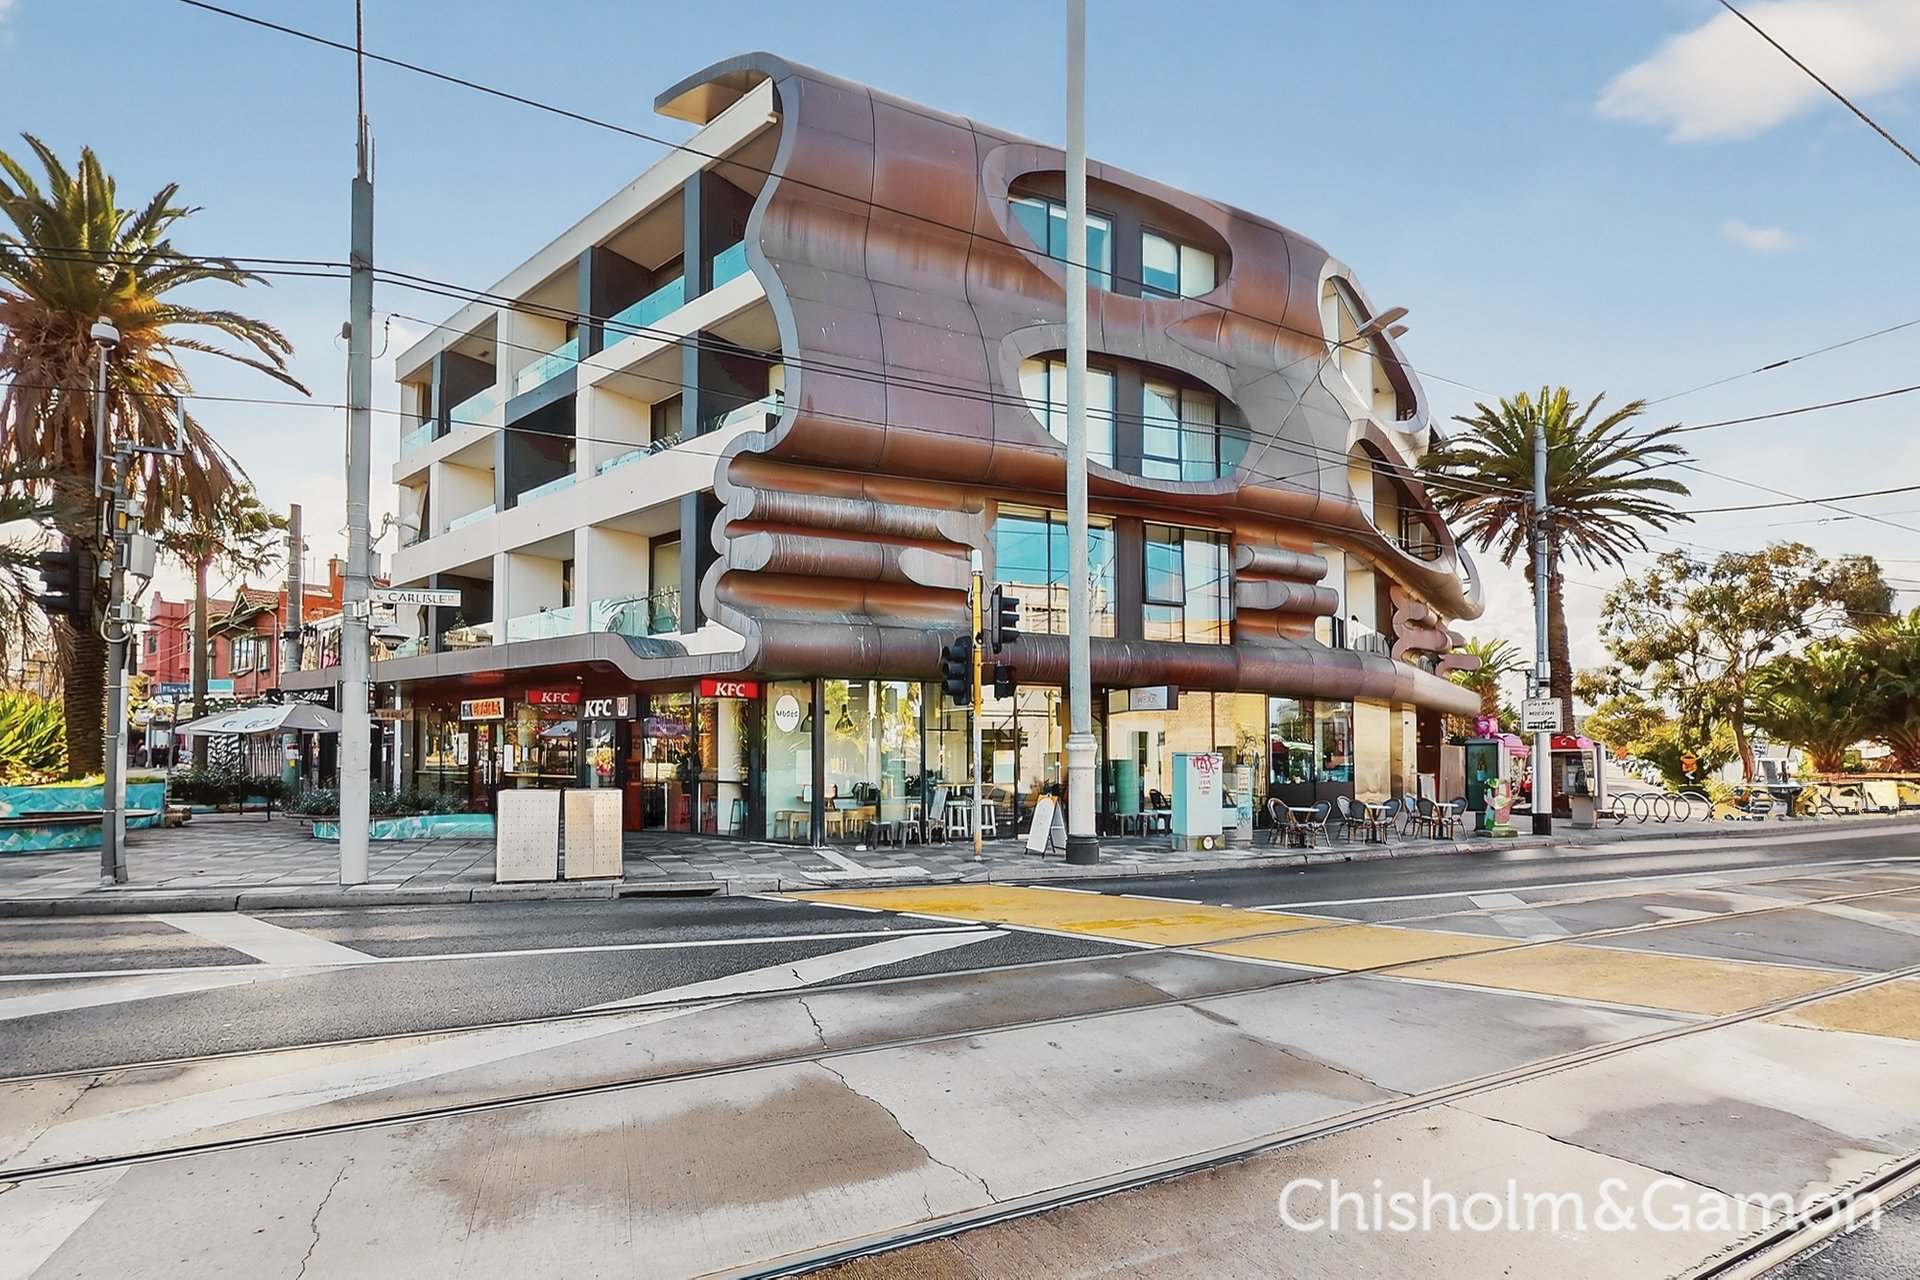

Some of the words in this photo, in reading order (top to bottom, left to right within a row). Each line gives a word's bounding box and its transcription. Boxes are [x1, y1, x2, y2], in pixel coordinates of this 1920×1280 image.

[388, 592, 445, 604] CARLISLE
[715, 682, 745, 697] KFC
[541, 692, 570, 703] KFC
[584, 699, 612, 718] KFC
